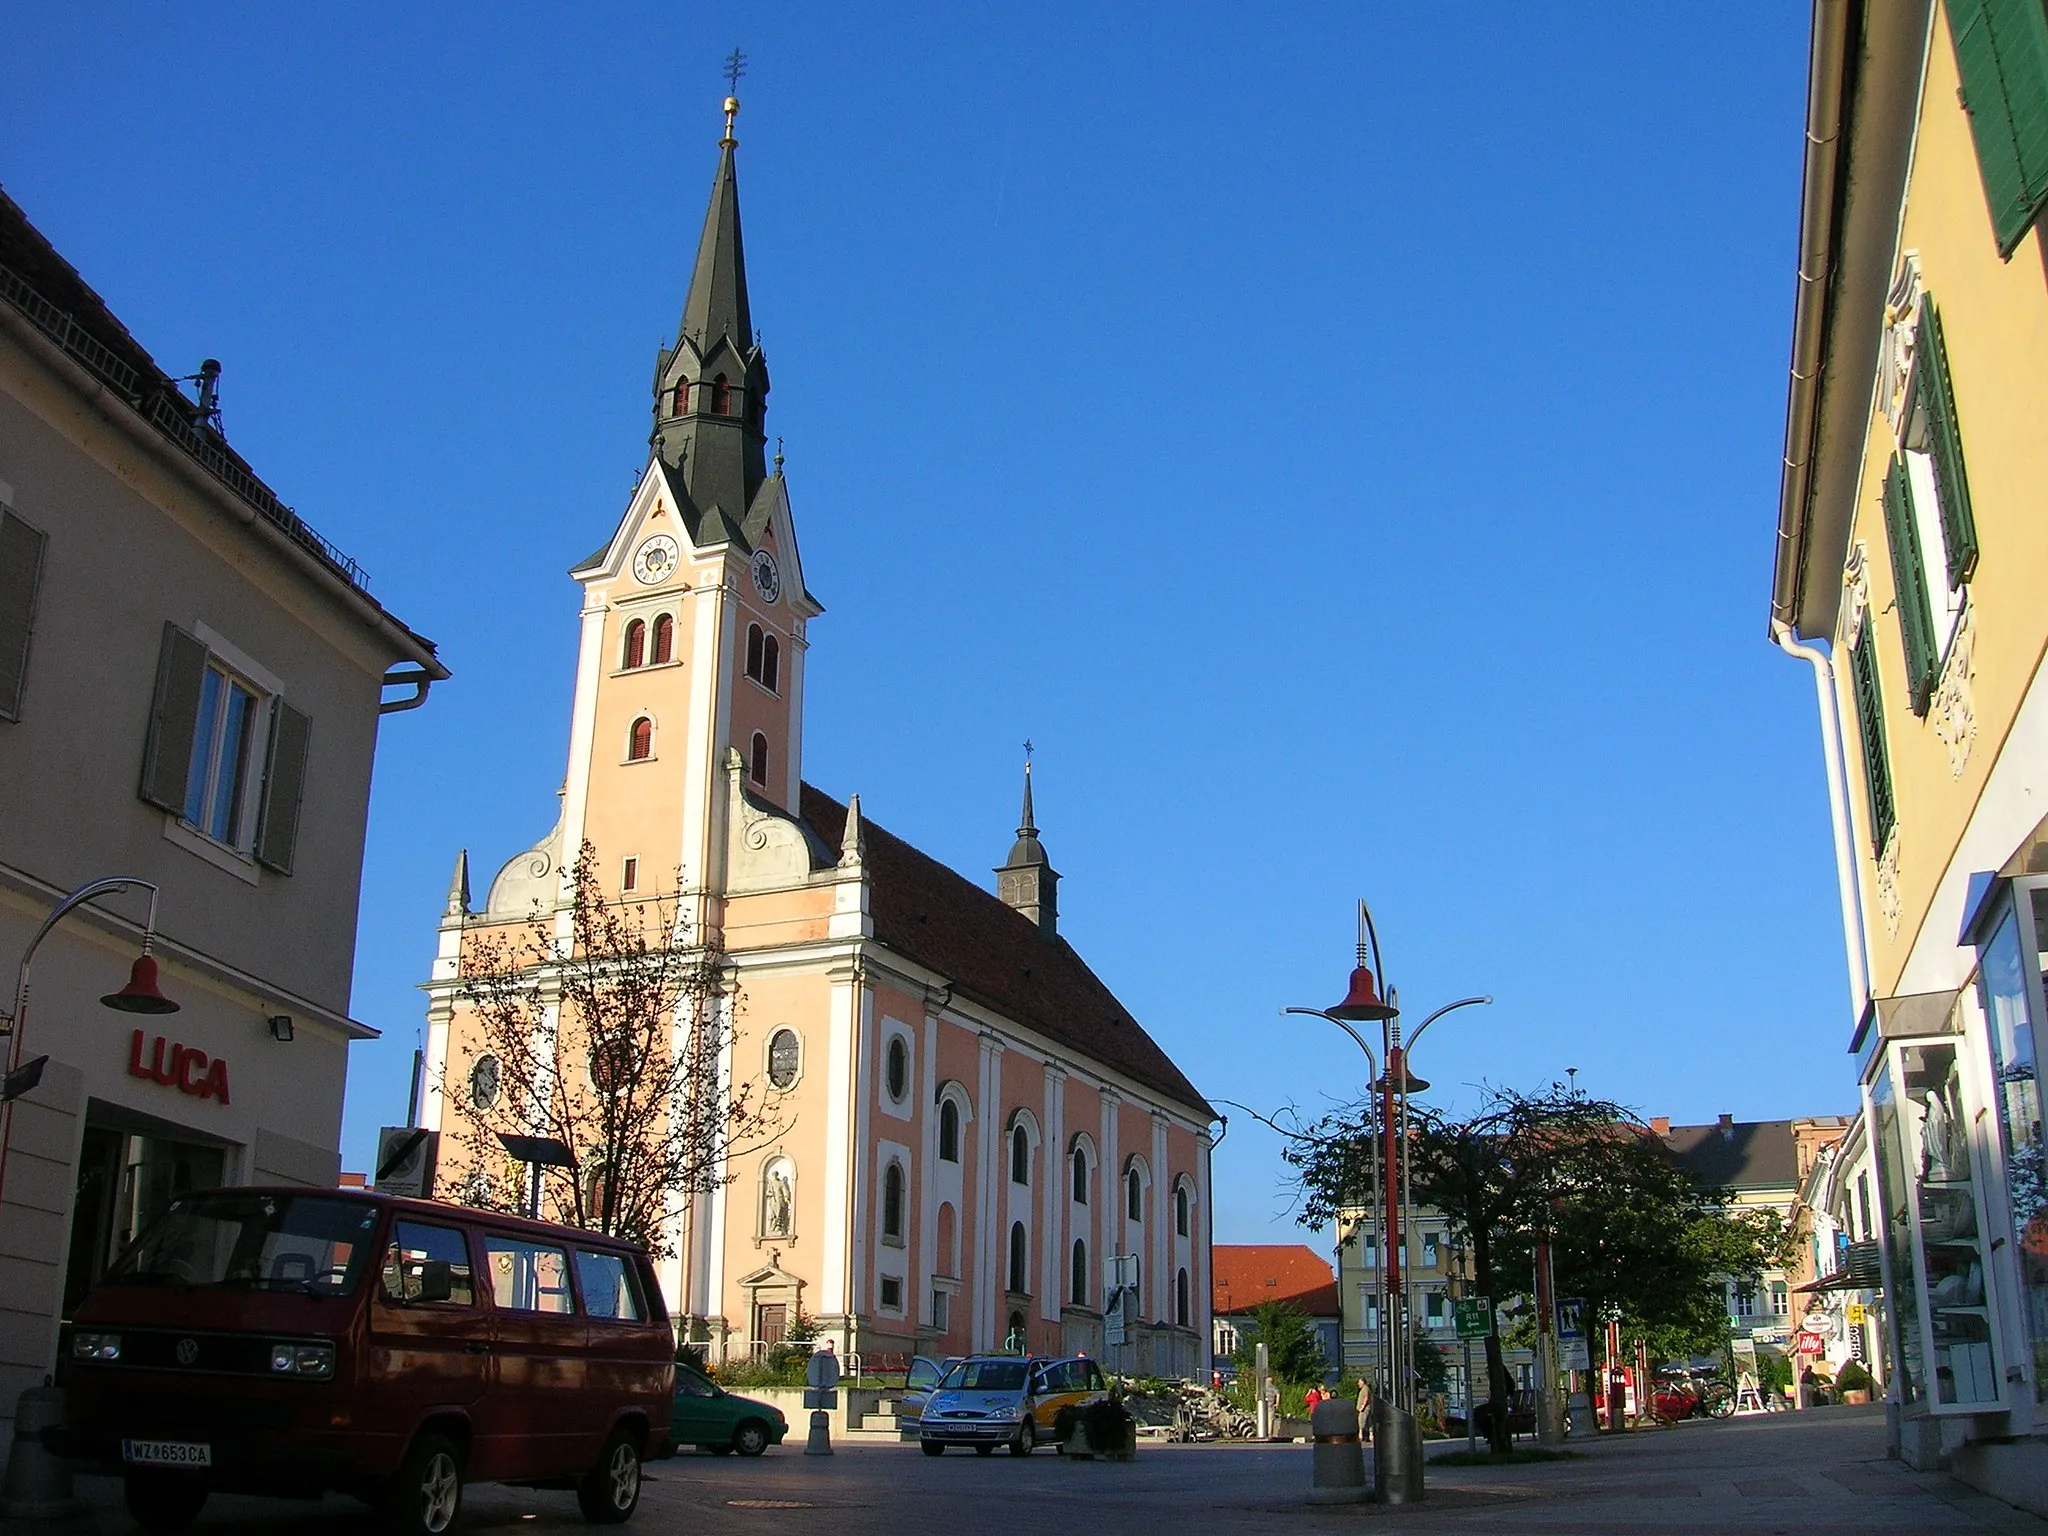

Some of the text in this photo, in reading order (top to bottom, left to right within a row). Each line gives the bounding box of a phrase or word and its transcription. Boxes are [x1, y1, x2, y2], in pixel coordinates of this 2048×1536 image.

[129, 1028, 231, 1106] LUCA
[1465, 1312, 1479, 1321] R11
[1800, 1335, 1819, 1351] illy
[133, 1443, 151, 1459] WZ
